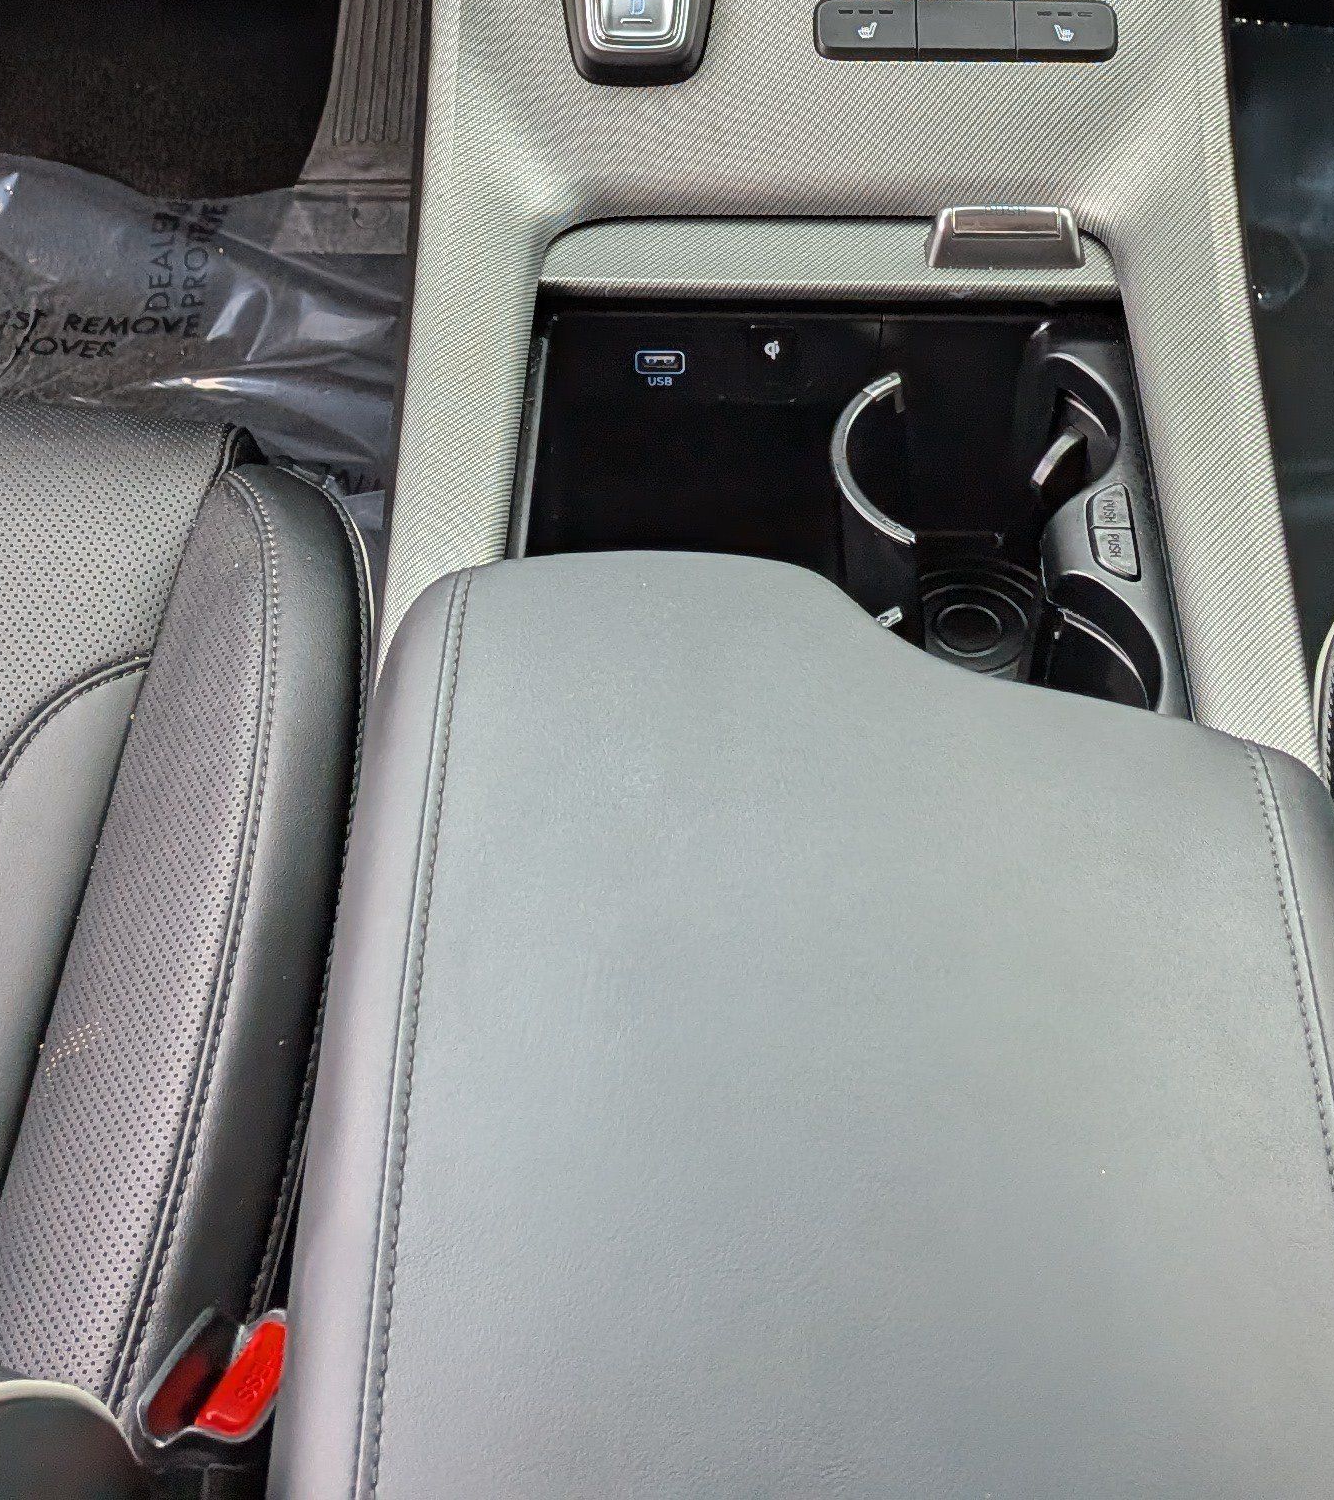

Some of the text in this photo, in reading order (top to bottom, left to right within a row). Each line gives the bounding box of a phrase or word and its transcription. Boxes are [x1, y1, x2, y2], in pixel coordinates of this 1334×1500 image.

[64, 312, 203, 339] REMOVE
[647, 376, 673, 387] USB
[1107, 533, 1122, 558] PUSH
